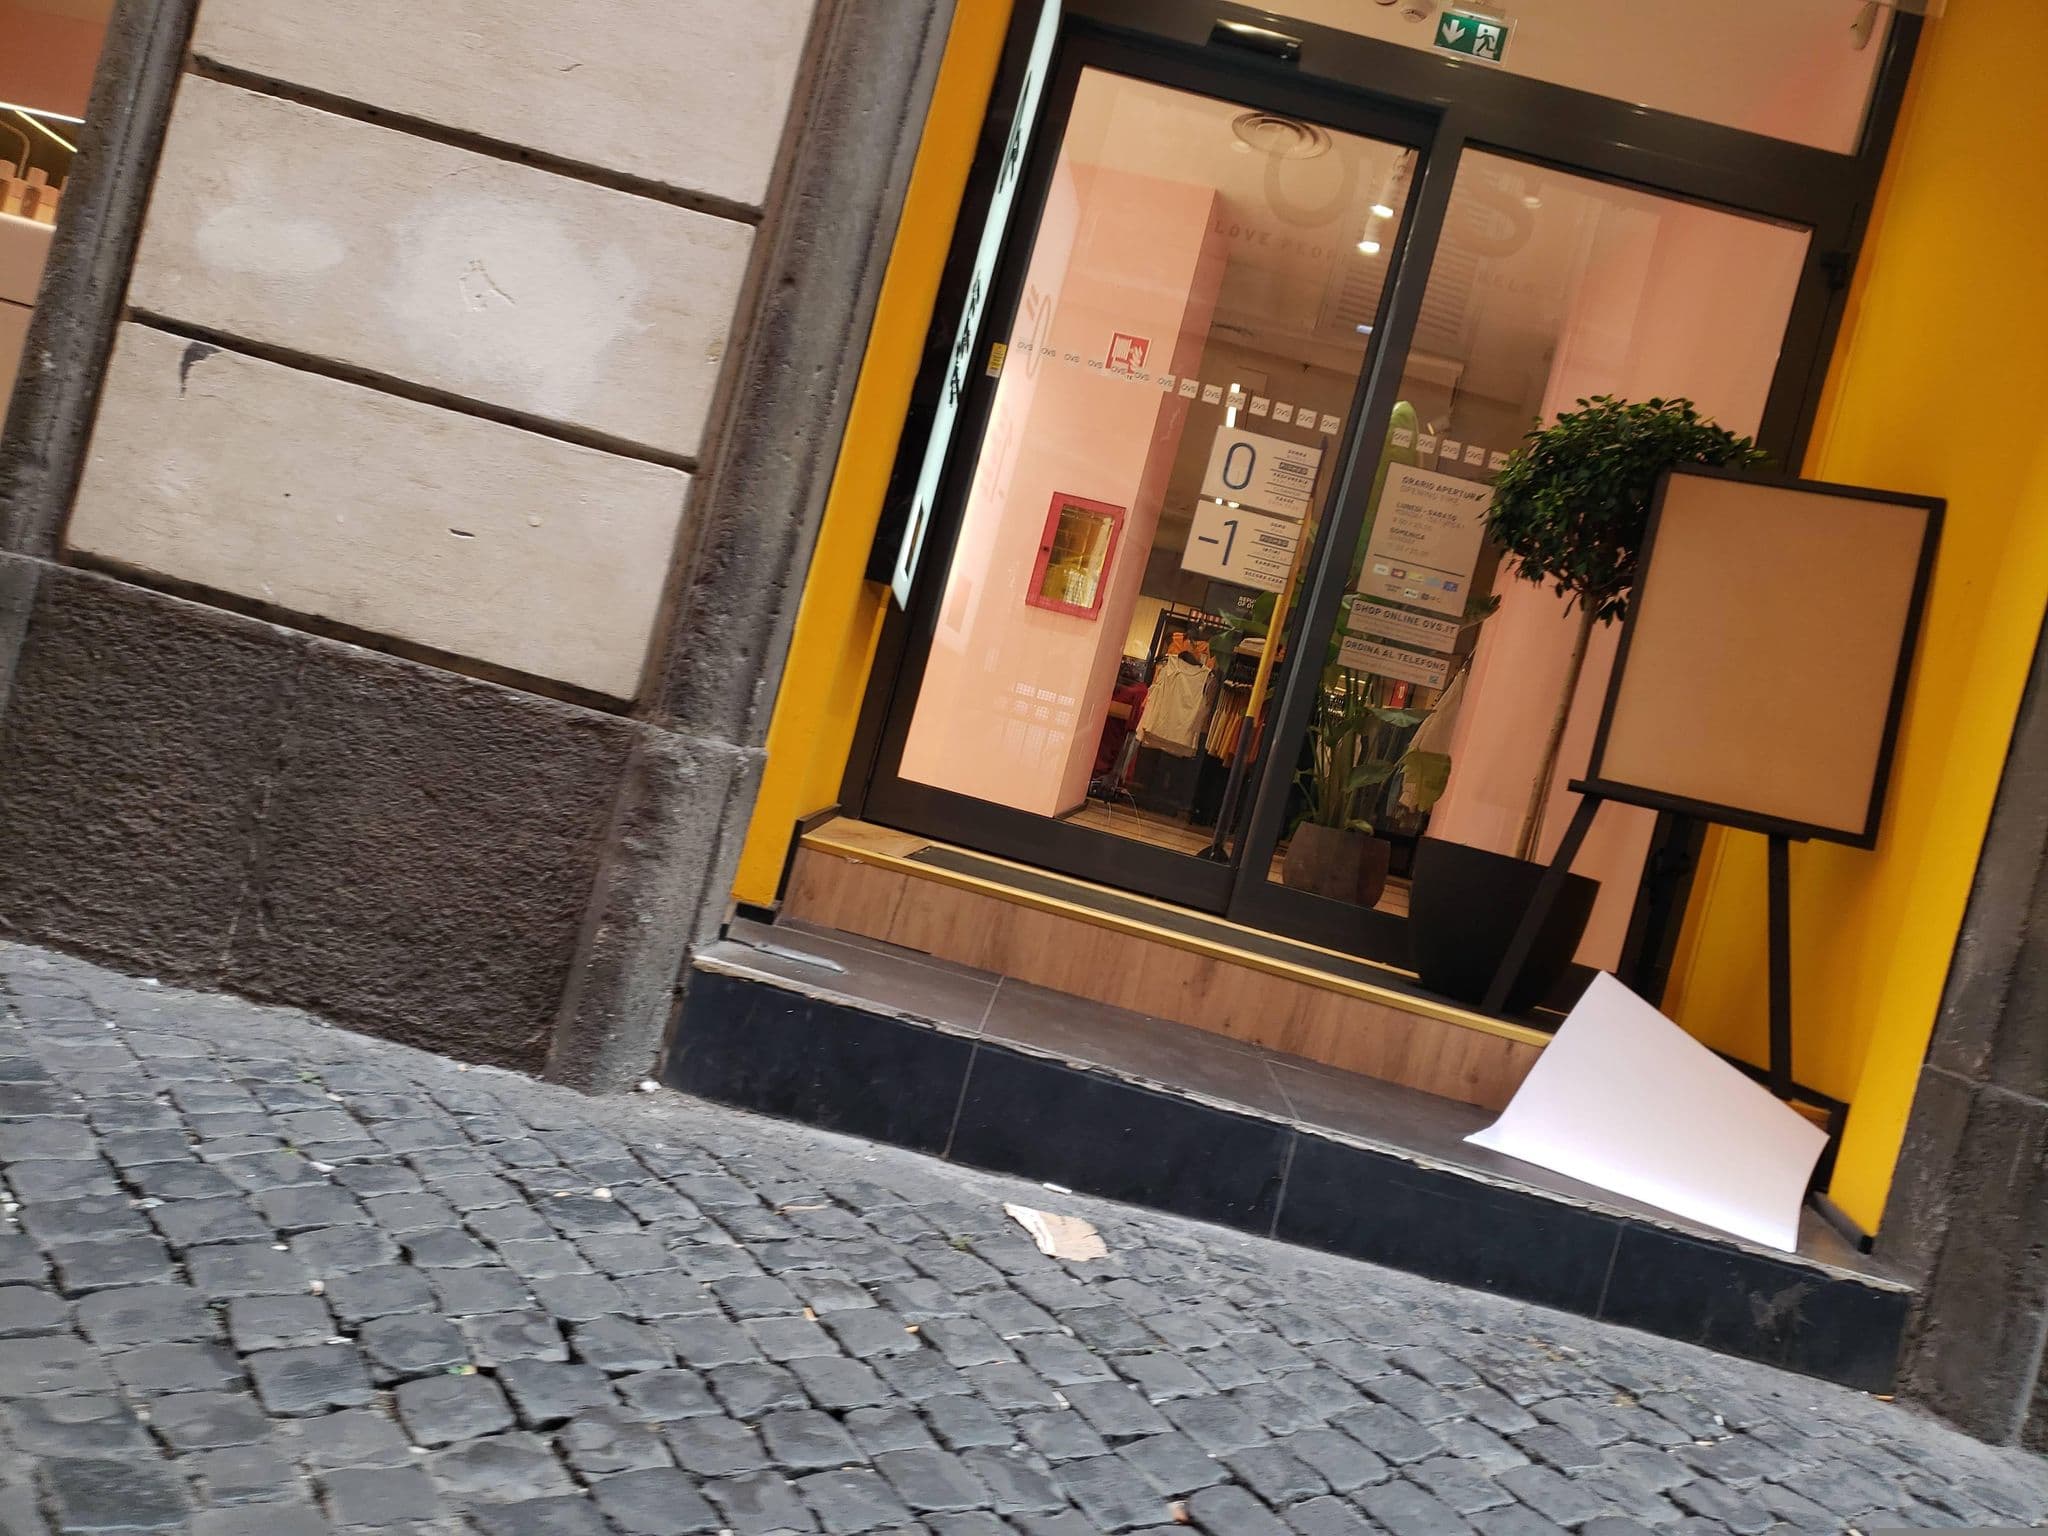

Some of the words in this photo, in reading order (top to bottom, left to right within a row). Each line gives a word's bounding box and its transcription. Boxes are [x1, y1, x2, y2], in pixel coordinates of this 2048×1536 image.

[1223, 443, 1256, 489] 0
[1198, 520, 1238, 566] -1
[1354, 603, 1382, 616] SHOP
[1383, 610, 1418, 625] ONLINE
[1344, 640, 1380, 655] ORDINA
[1382, 650, 1394, 658] AL
[1397, 653, 1446, 672] TELEFONO
